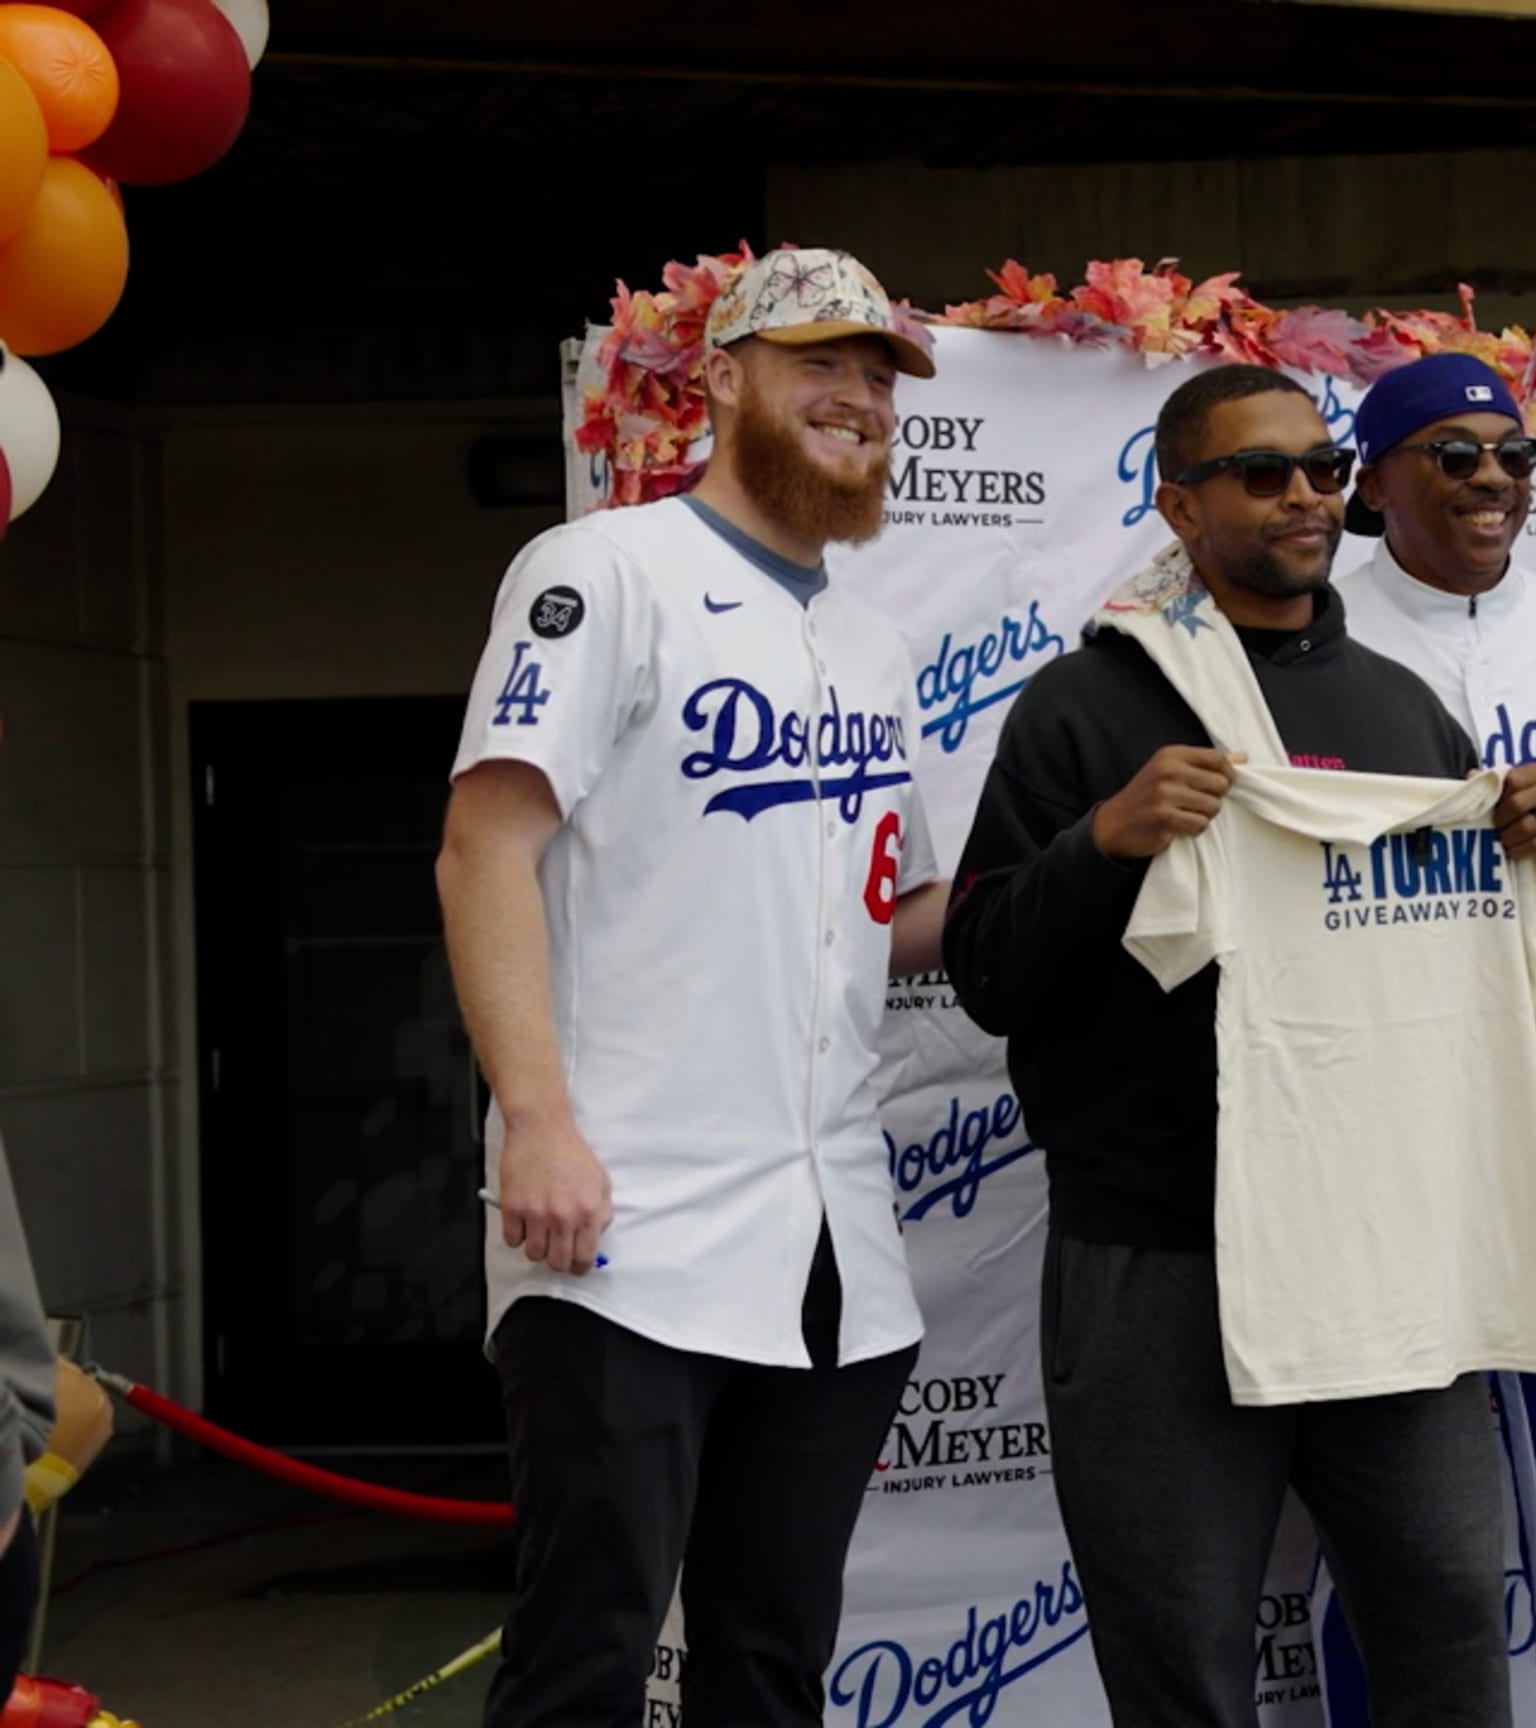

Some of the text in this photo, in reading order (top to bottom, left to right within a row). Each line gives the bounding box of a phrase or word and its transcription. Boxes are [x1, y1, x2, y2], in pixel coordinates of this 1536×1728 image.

[893, 415, 985, 451] OBY
[883, 511, 1013, 527] JURY LAWYERS
[536, 601, 573, 632] 34
[492, 641, 551, 726] LA
[916, 600, 1065, 753] dgers
[1320, 826, 1504, 903] LA TURKE
[1324, 898, 1516, 931] GIVEAWAY 202
[885, 996, 935, 1011] NJURY
[882, 1093, 1036, 1222] odge
[898, 1373, 1006, 1416] COBY
[876, 1420, 1051, 1470] MEYER
[882, 1466, 1036, 1494] INJURY LAWYERS
[829, 1561, 1091, 1728] Dodgers
